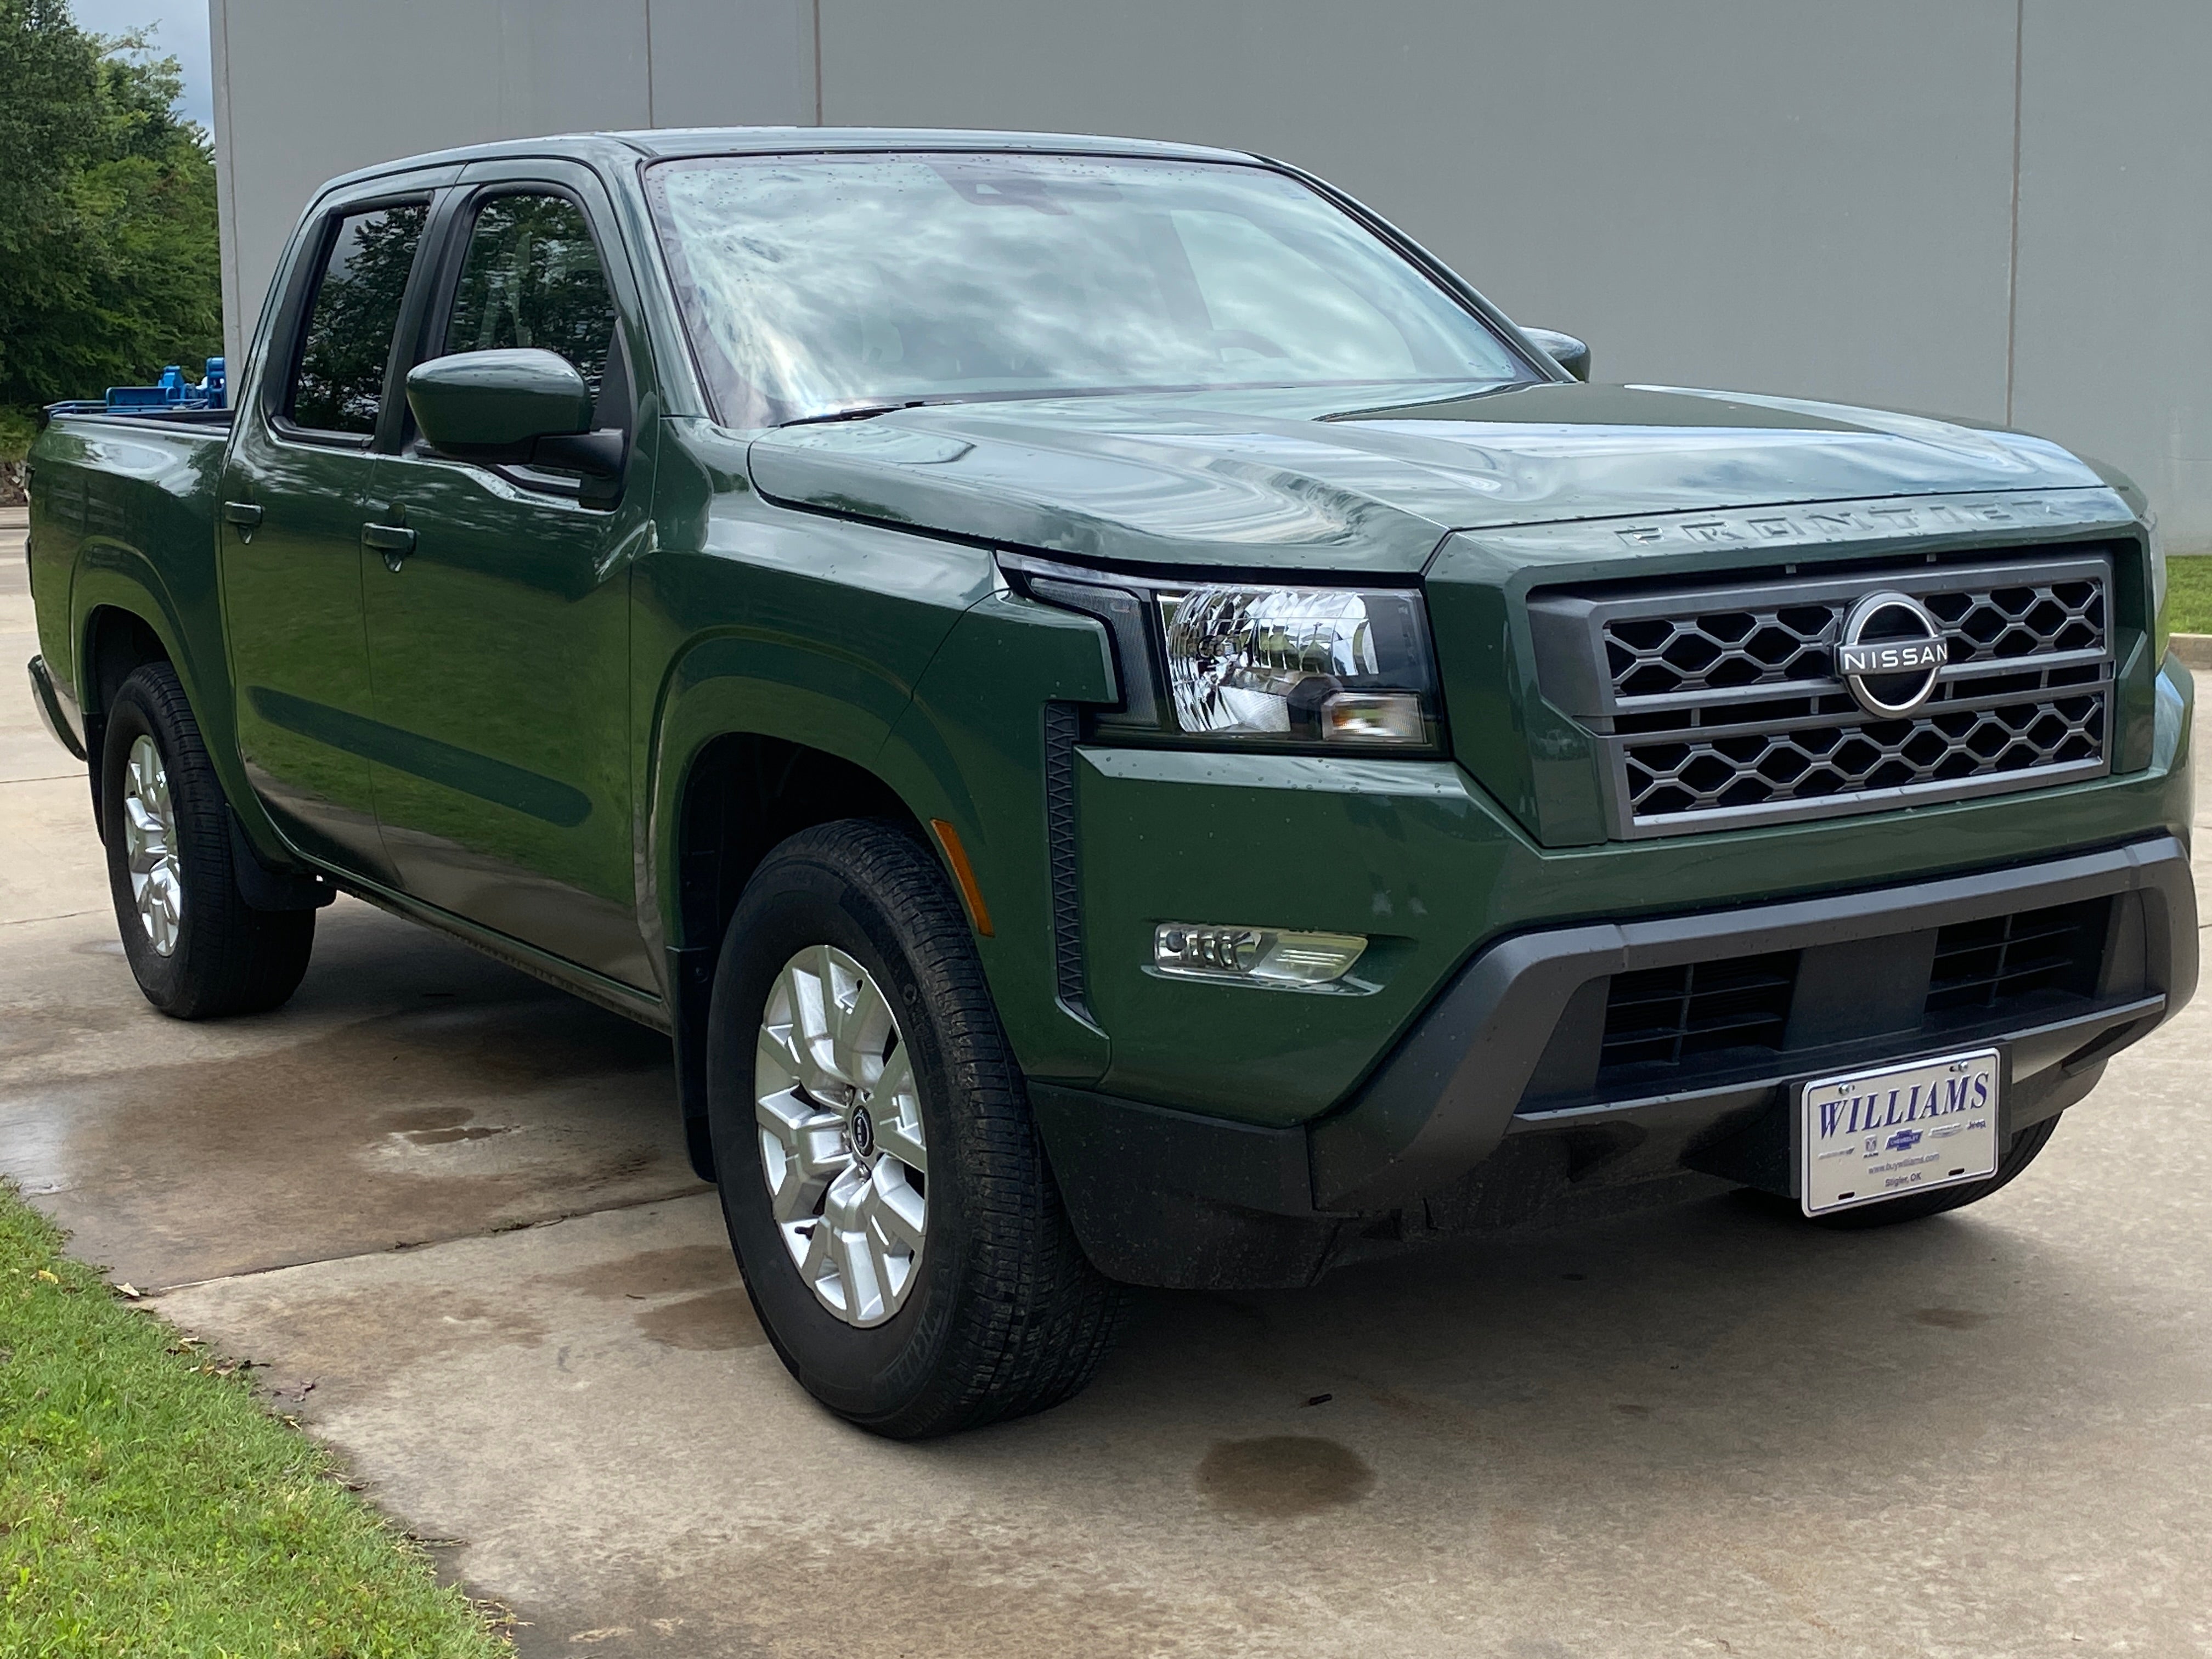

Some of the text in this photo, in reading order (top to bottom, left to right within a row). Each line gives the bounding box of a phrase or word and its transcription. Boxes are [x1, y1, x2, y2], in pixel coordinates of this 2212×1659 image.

[1844, 643, 1947, 670] NISSAN
[1818, 1071, 1990, 1140] WILLIAMS
[1911, 1172, 1921, 1181] OK
